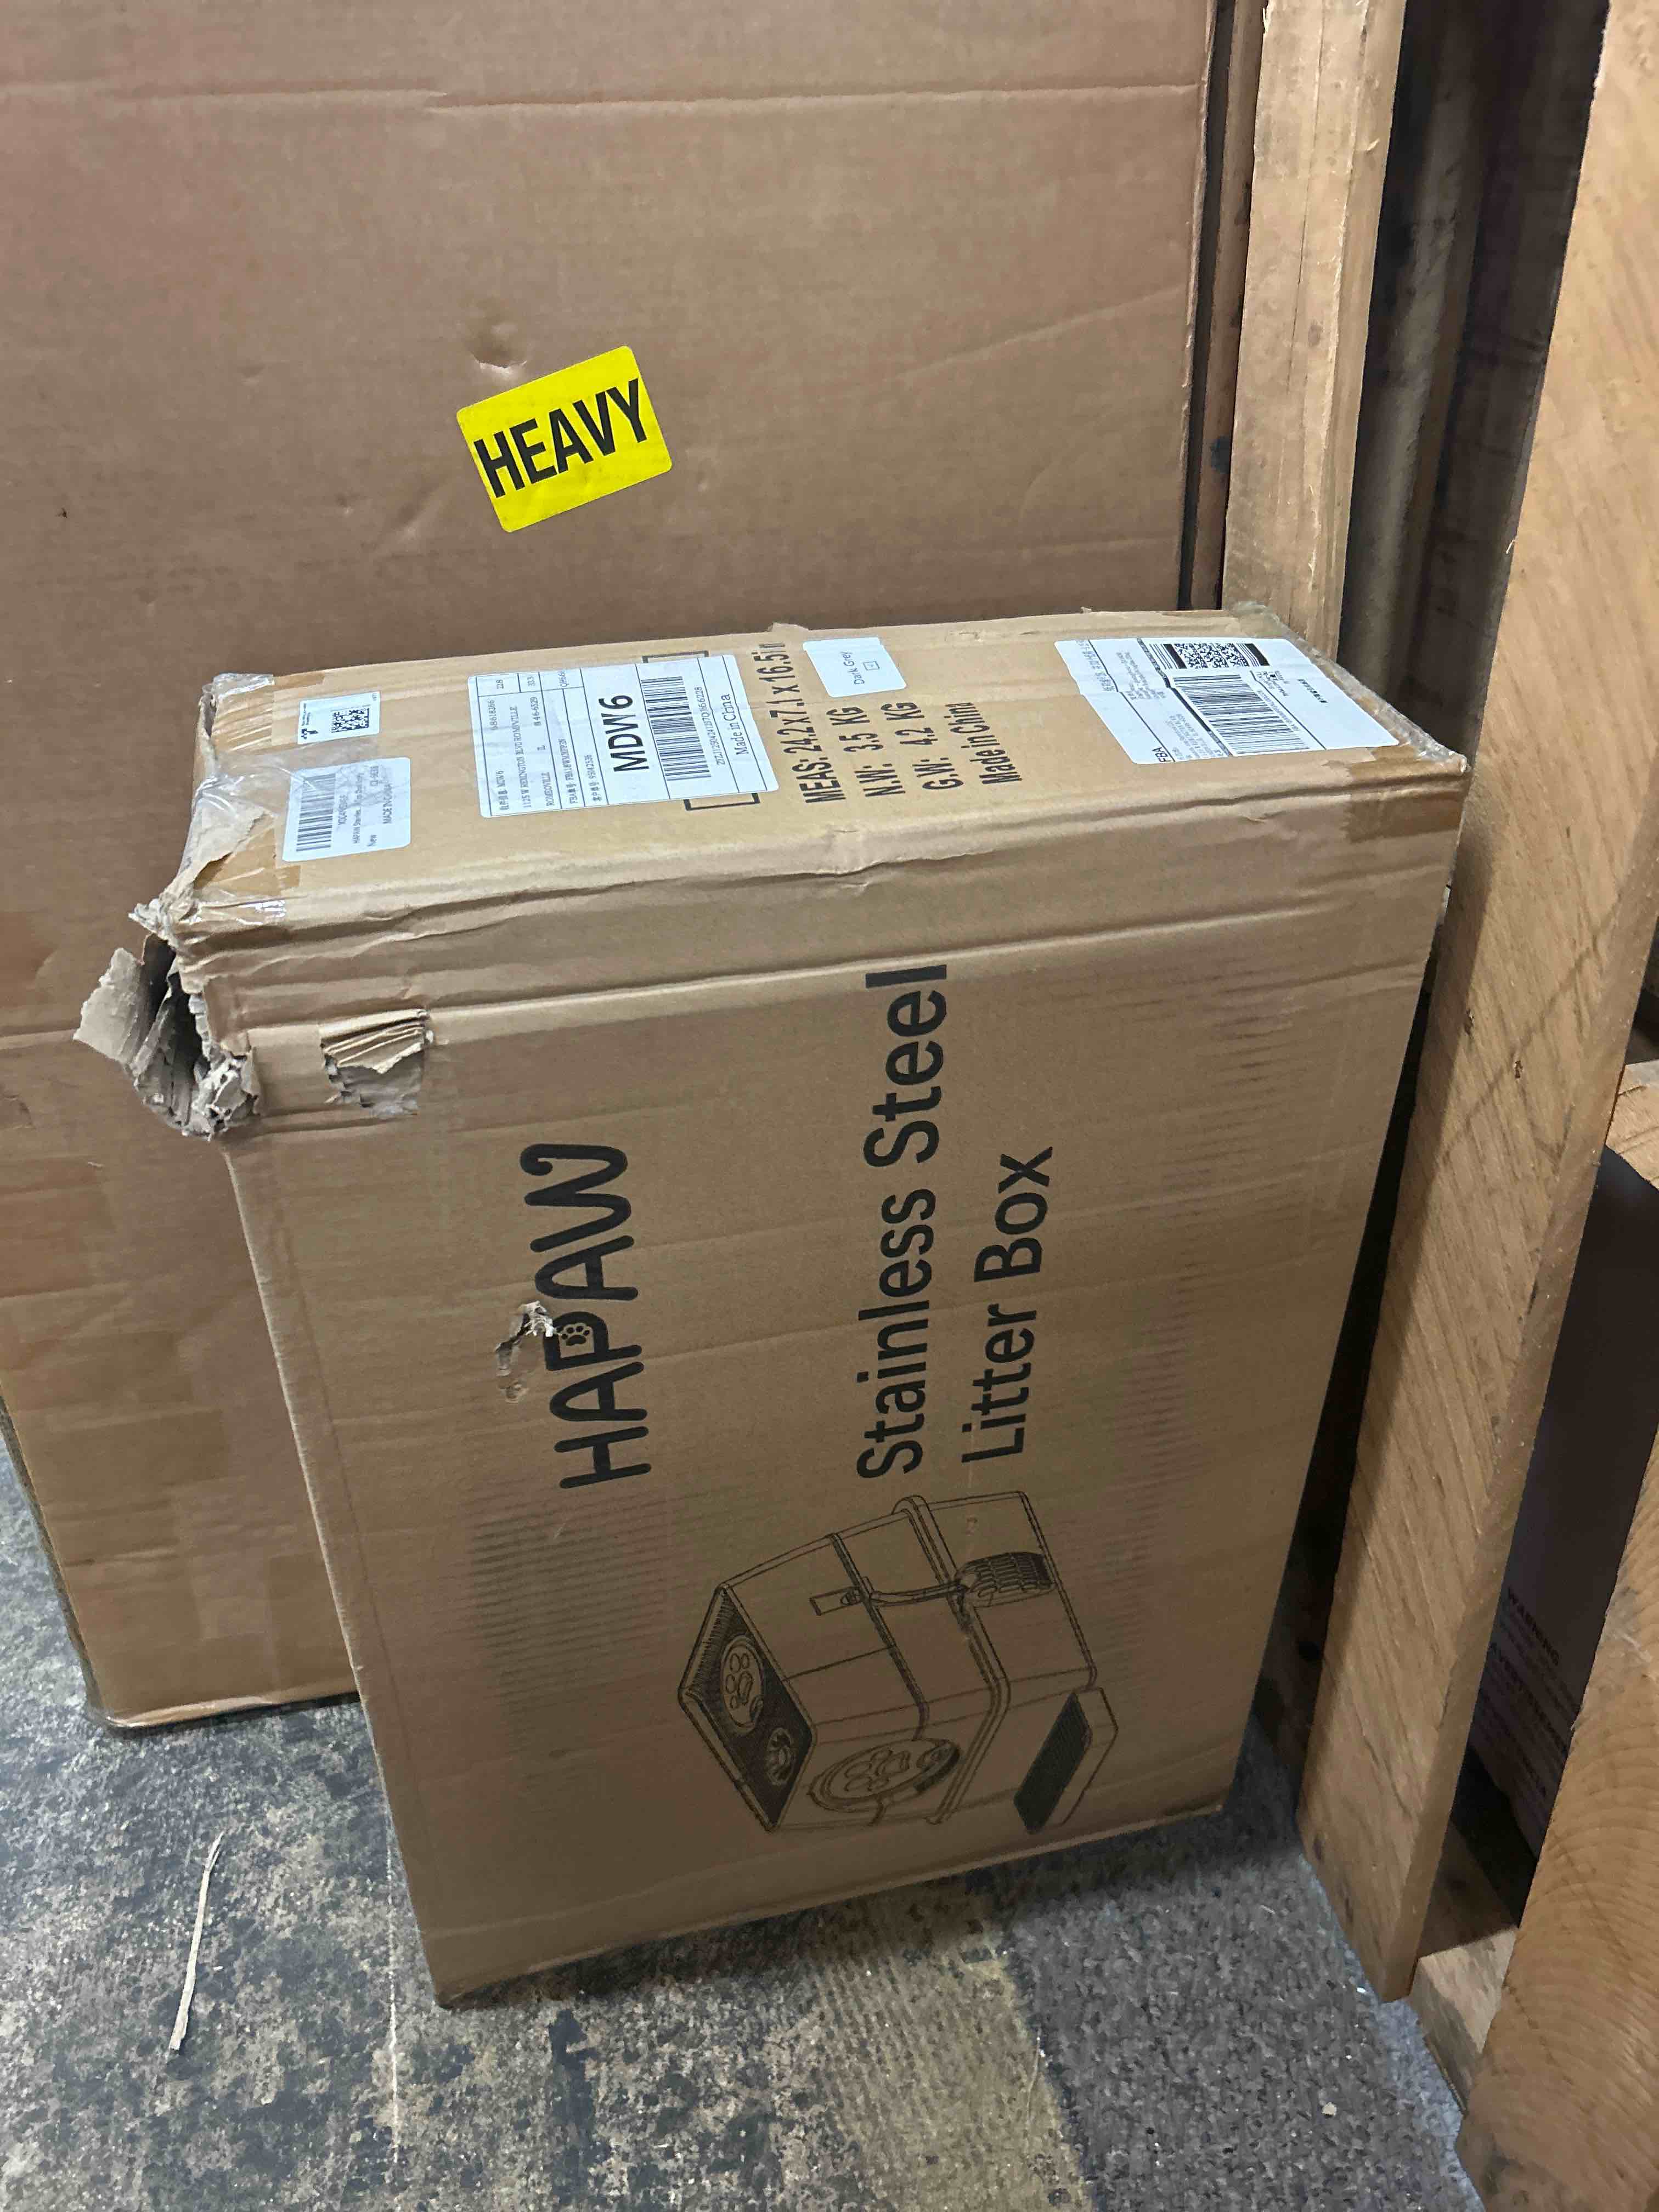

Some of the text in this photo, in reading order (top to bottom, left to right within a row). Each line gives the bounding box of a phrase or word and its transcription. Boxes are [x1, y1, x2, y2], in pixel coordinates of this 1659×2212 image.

[474, 377, 647, 498] HEAVY
[719, 693, 736, 721] China
[840, 651, 865, 685] Dark Grey
[599, 695, 649, 772] MDW6
[730, 731, 748, 755] Made
[826, 707, 905, 797] N.W: 3.5 KG
[881, 702, 963, 790] G.W: 4.2 KG
[944, 702, 1022, 784] Made in China
[1152, 747, 1171, 762] FBA
[792, 757, 847, 803] MEAS:
[857, 964, 946, 1479] Stainless Steel
[519, 1143, 651, 1488] HAPAW
[962, 1146, 1053, 1462] Litter Box
